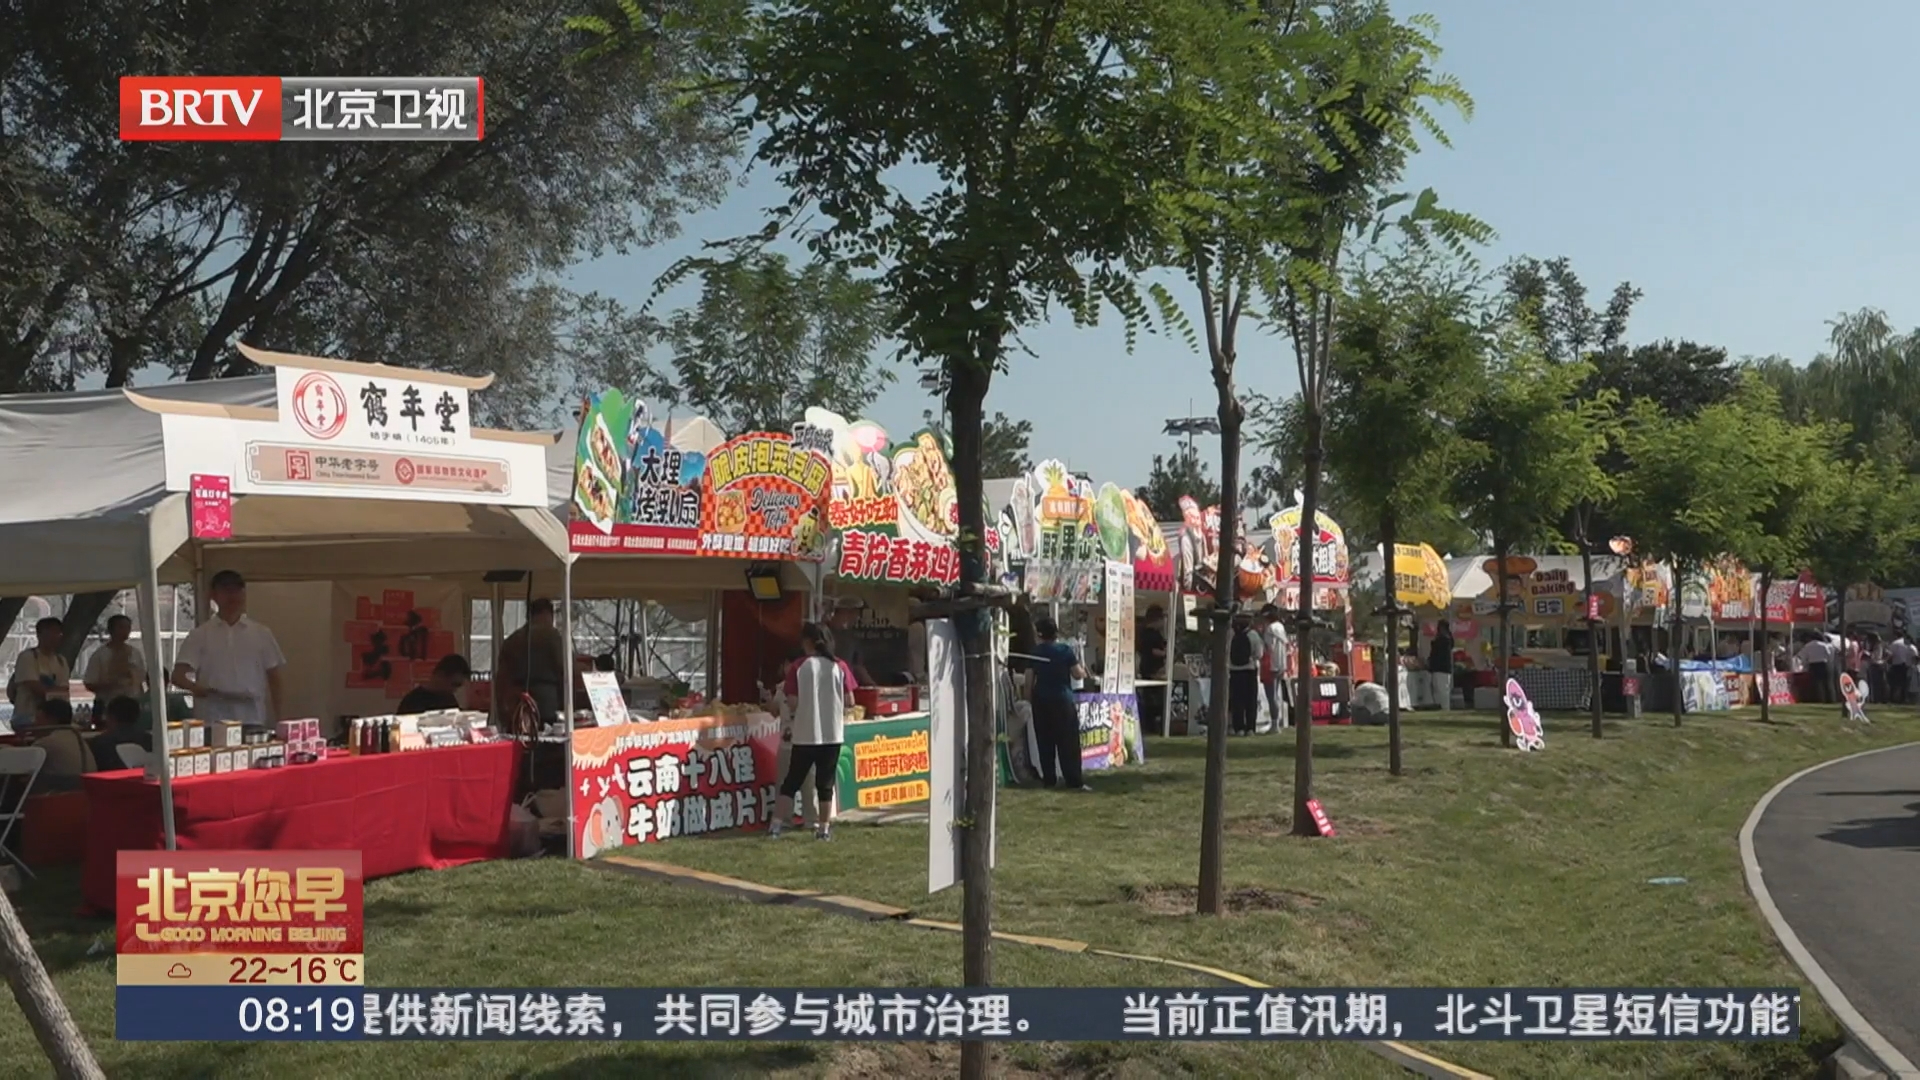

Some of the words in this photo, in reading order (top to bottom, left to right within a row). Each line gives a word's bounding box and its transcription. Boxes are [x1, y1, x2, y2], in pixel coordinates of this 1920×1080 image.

[315, 455, 379, 472] 中华老字号
[640, 447, 681, 485] 大理
[711, 439, 827, 493] 脆皮泡菜豆腐
[635, 488, 701, 525] 烤乳扇
[751, 487, 800, 512] Delicious
[764, 508, 789, 531] Tofu
[1535, 568, 1568, 583] Daily
[627, 746, 756, 798] 云南十八怪
